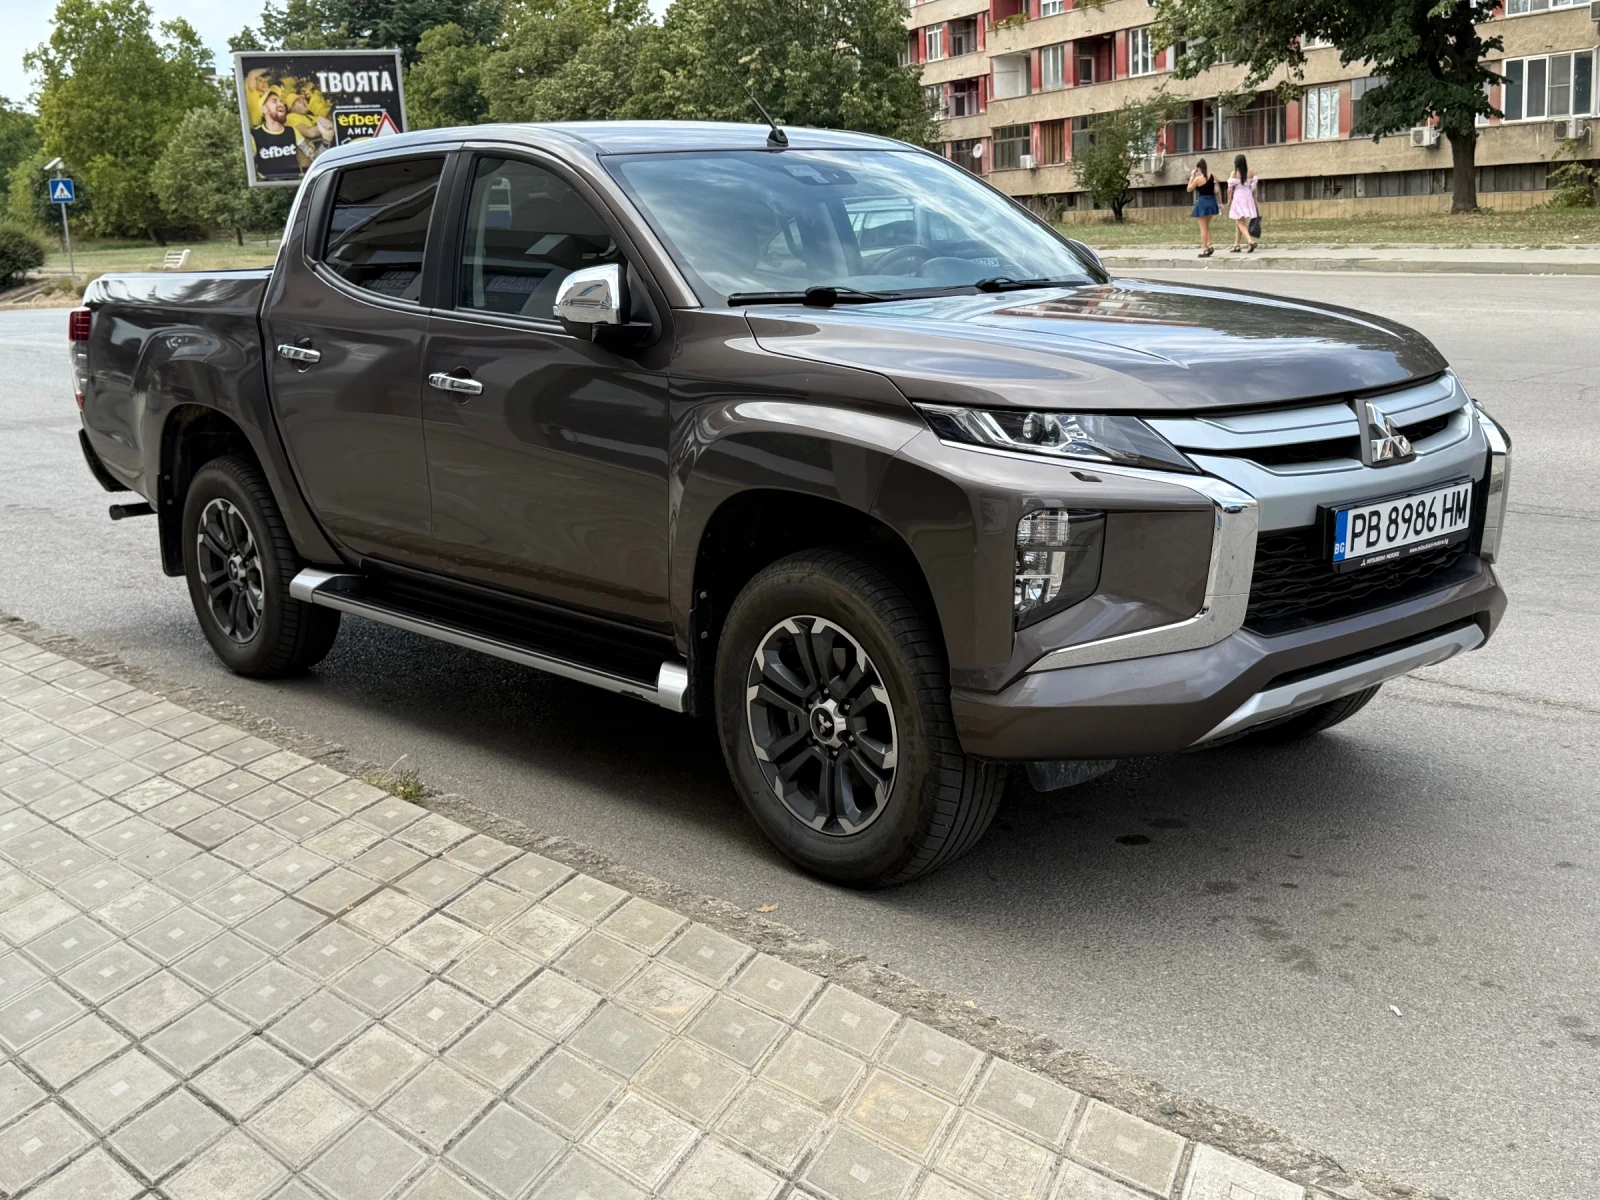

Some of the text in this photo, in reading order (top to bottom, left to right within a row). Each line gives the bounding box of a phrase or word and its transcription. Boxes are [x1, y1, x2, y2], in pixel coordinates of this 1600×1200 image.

[316, 70, 394, 93] ТВОЯТА
[337, 113, 381, 126] efbet
[347, 127, 375, 136] ЛИГА
[259, 143, 297, 160] efbet
[1350, 488, 1469, 552] PB 8986 HM
[1334, 542, 1345, 555] BG
